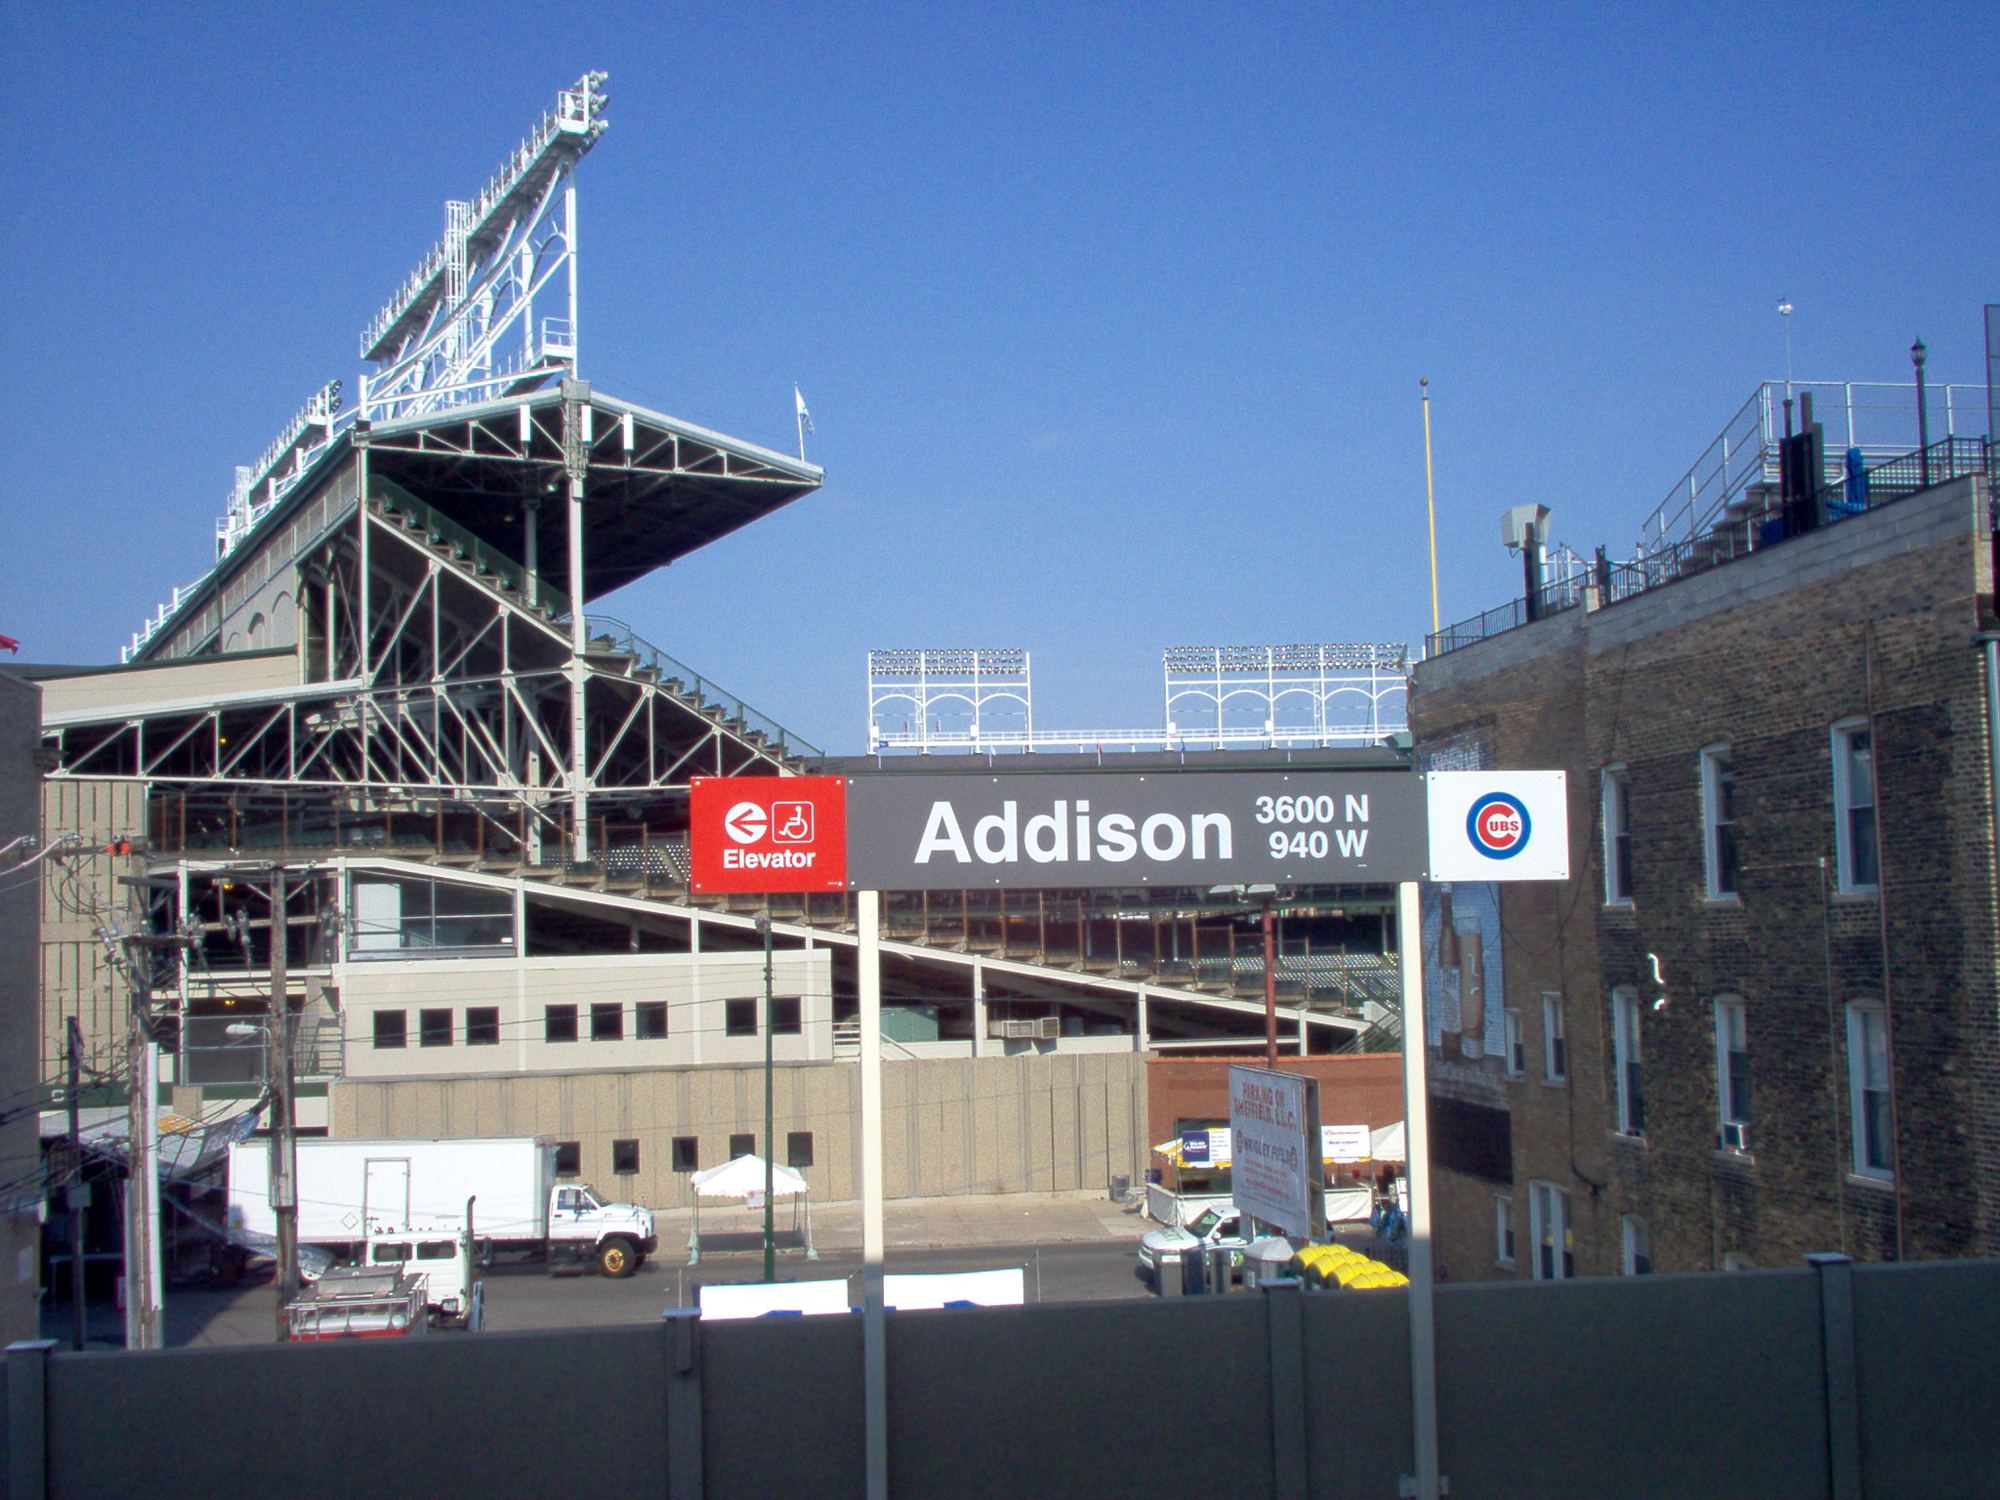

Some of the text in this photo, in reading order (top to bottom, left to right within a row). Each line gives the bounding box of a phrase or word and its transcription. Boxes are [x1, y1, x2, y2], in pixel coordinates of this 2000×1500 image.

[1255, 793, 1369, 824] 3600 N
[914, 799, 1233, 865] Addison
[1477, 803, 1519, 848] CUBS
[723, 848, 816, 869] Elevator
[1268, 829, 1369, 860] 940 W
